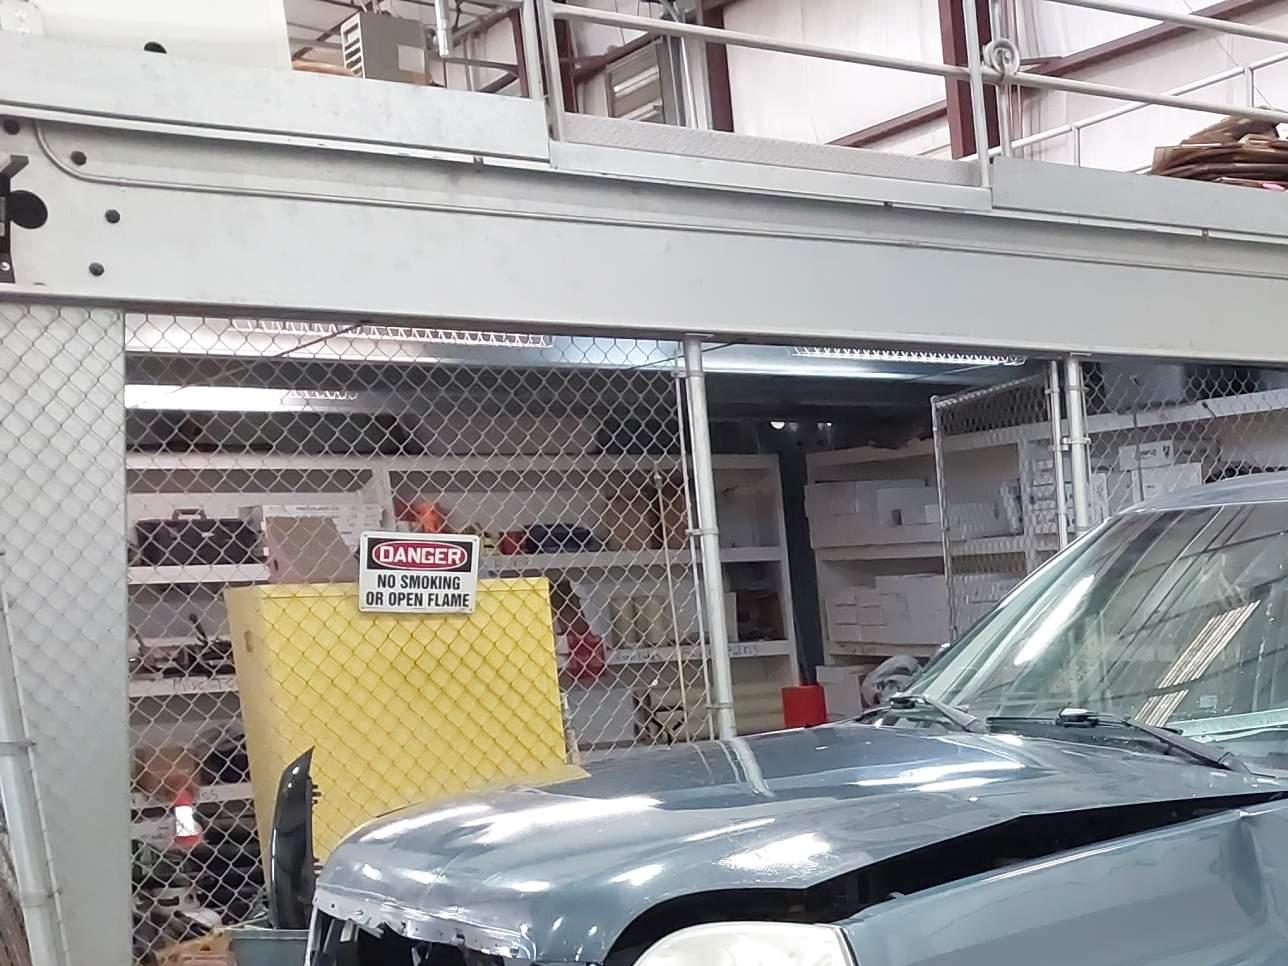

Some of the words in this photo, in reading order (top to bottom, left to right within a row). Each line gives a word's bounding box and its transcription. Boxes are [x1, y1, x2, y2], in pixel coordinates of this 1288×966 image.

[379, 546, 462, 565] DANGER
[377, 574, 396, 589] NO
[400, 574, 461, 590] SMOKING
[366, 591, 384, 606] OR
[388, 592, 423, 607] OPEN
[427, 593, 470, 608] FLAME
